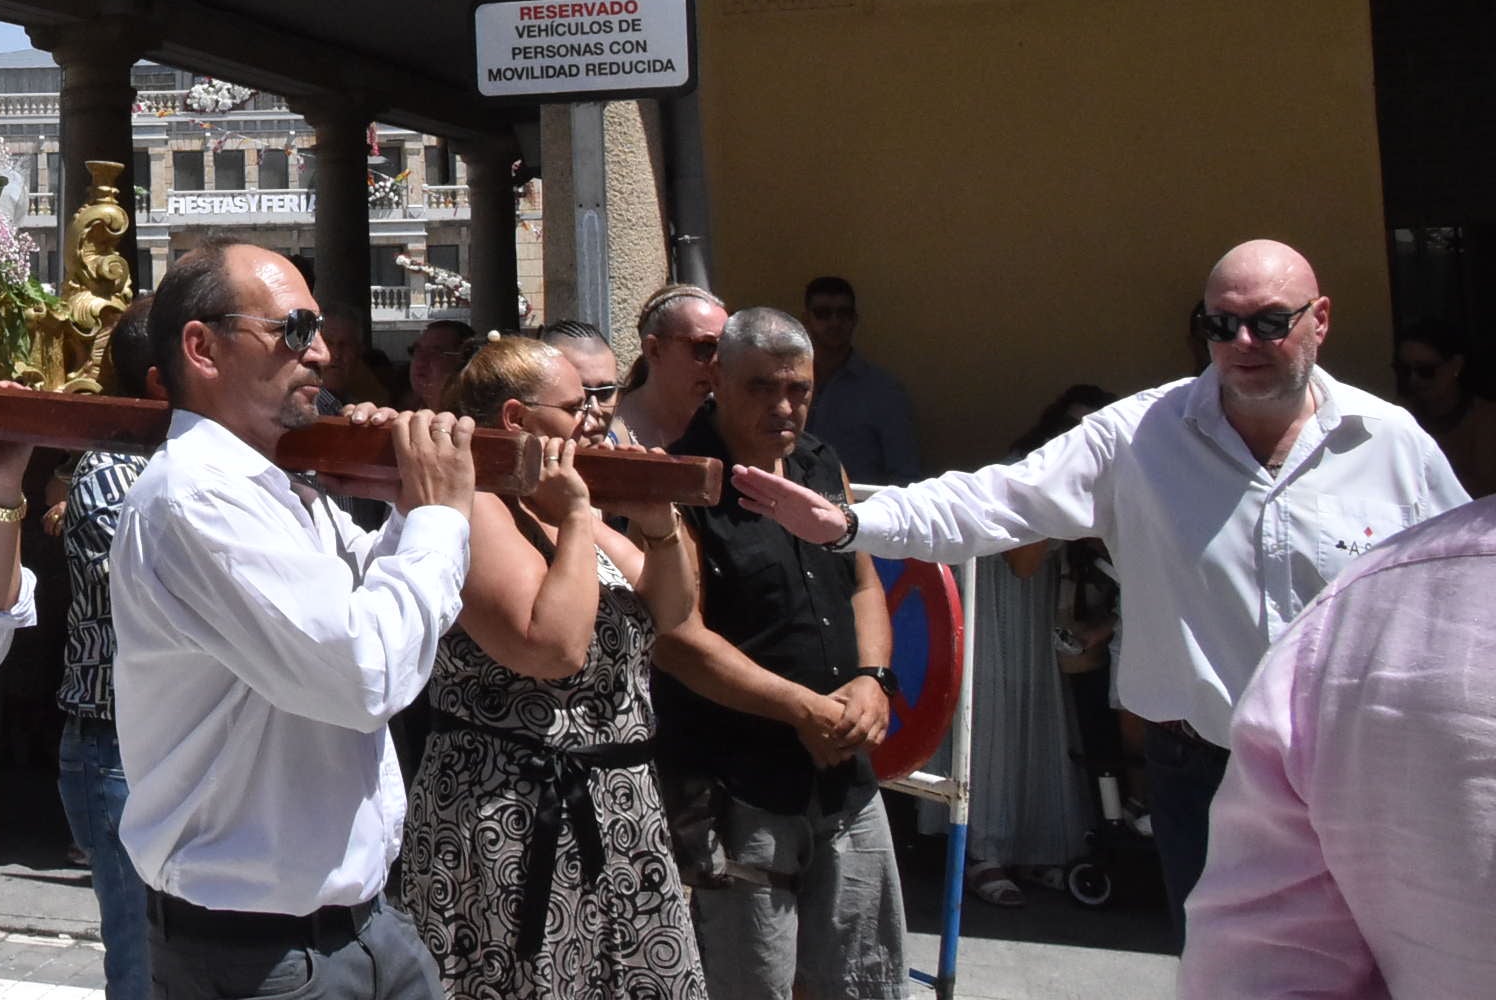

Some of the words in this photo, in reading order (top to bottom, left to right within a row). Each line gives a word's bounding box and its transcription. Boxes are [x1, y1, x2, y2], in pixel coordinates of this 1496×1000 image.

[519, 0, 639, 21] RESERVADO
[514, 19, 614, 39] VEHÍCULOS
[618, 18, 643, 33] DE
[511, 42, 605, 61] PERSONAS
[608, 39, 648, 55] CON
[487, 63, 581, 83] MOVILIDAD
[584, 58, 676, 77] REDUCIDA
[167, 195, 248, 215] FIESTAS
